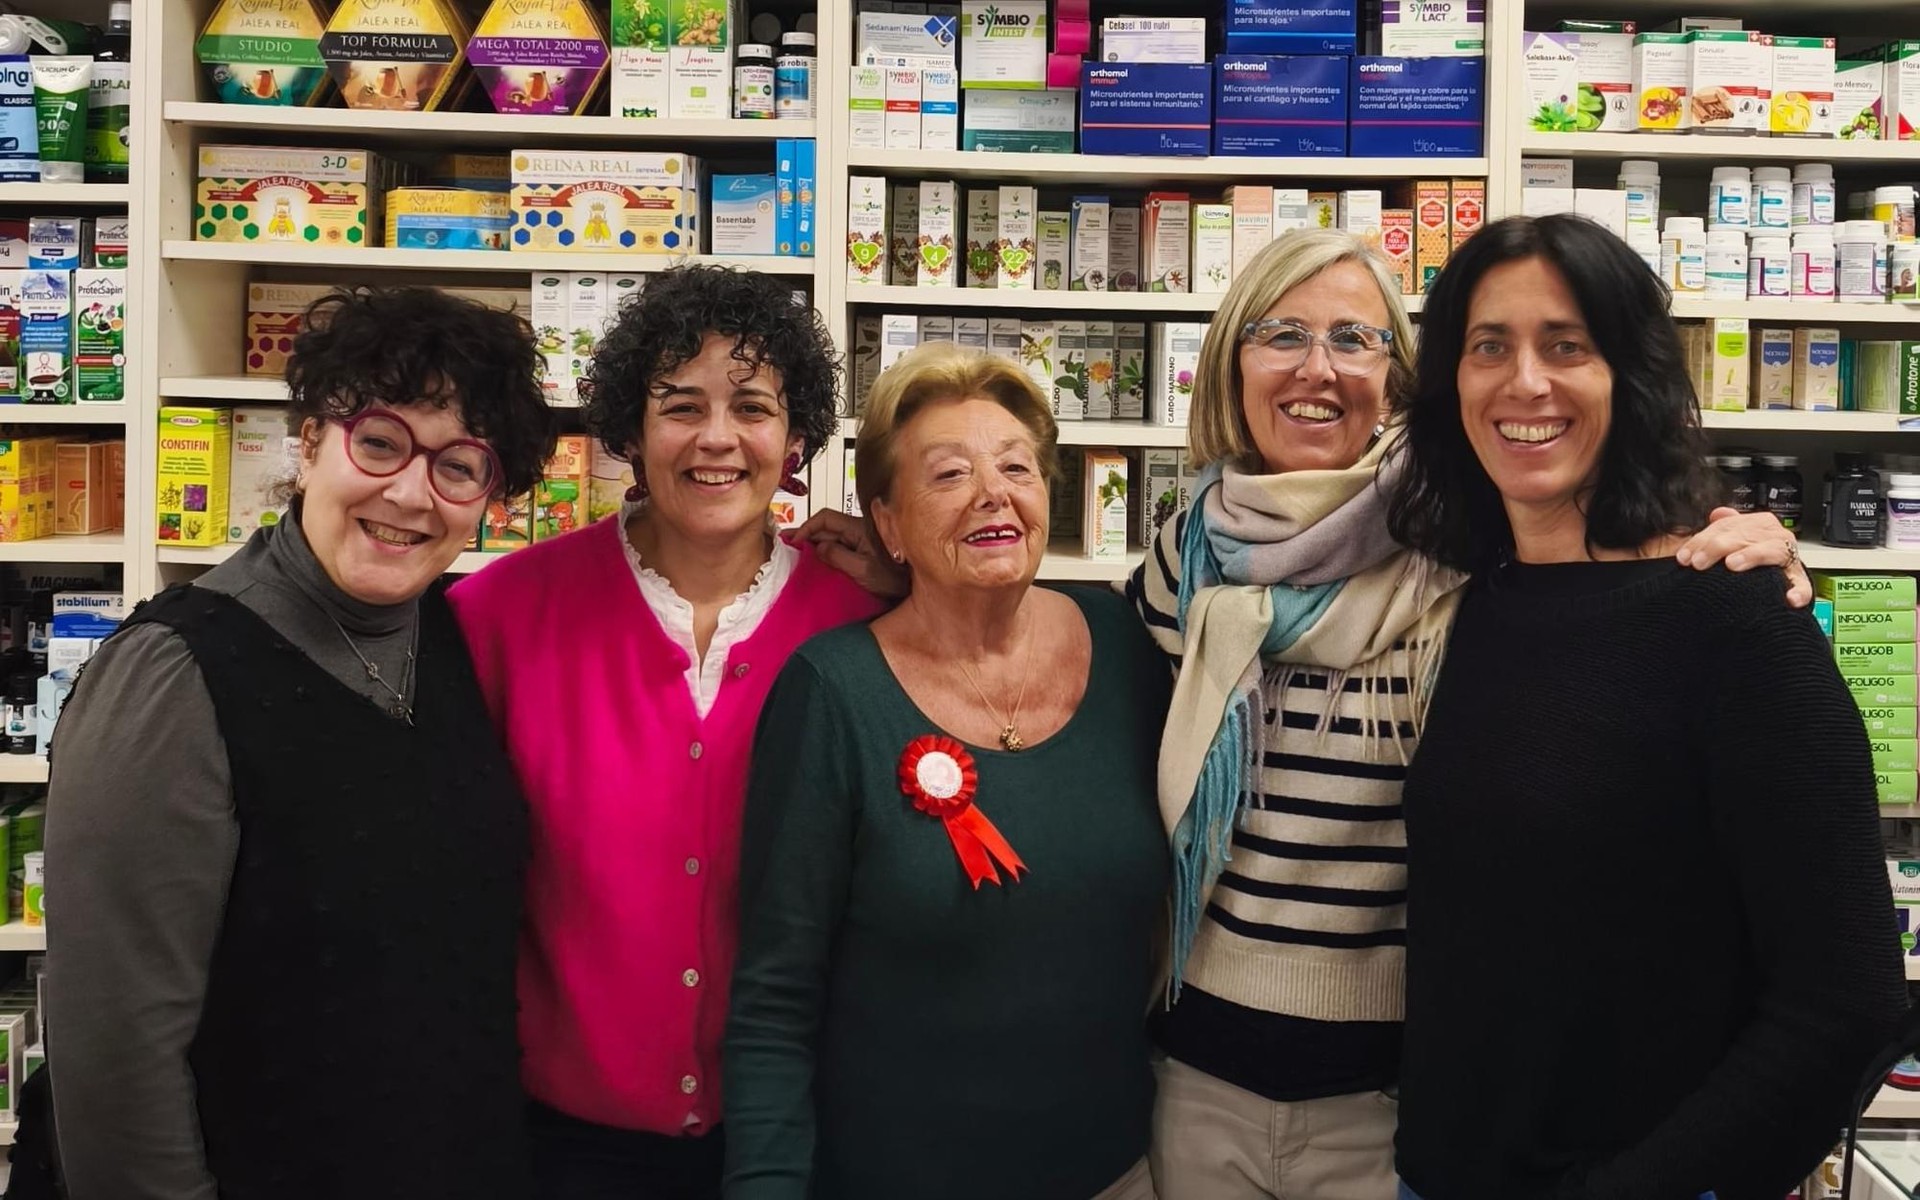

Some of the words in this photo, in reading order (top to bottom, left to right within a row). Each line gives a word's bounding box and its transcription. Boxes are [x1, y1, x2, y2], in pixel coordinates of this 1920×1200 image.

[1234, 7, 1299, 16] Micronutrientes
[1301, 8, 1351, 17] importantes
[1410, 3, 1451, 14] SYMBIO
[240, 17, 271, 27] JALEA
[276, 19, 300, 28] REAL
[357, 17, 388, 26] JALEA
[394, 17, 419, 27] REAL
[977, 12, 1030, 31] SYMBIO
[1234, 17, 1253, 25] para
[1422, 13, 1447, 22] LACT
[511, 20, 541, 30] JALEA
[547, 21, 573, 30] REAL
[1153, 20, 1170, 30] nutri
[993, 28, 1025, 36] INTEST
[239, 40, 293, 53] STUDIO
[341, 36, 369, 47] TOP
[373, 35, 438, 48] FÓRMULA
[476, 39, 510, 49] MEGA
[515, 40, 551, 50] TOTAL
[554, 41, 582, 51] 2000
[585, 45, 599, 53] mg
[787, 59, 808, 67] robis
[1223, 61, 1267, 71] orthomol
[1360, 63, 1403, 72] orthomol
[1090, 69, 1128, 78] orthomol
[1223, 85, 1289, 94] Micronutrientes
[1291, 86, 1341, 95] importantes
[1844, 81, 1873, 89] Memory
[1090, 90, 1153, 99] Micronutrientes
[1155, 92, 1204, 101] importantes
[1451, 88, 1468, 96] para
[3, 96, 33, 105] CLASSIC
[1223, 95, 1242, 103] para
[1253, 95, 1291, 104] cartílago
[1359, 94, 1398, 102] formación
[1401, 103, 1422, 111] tejido
[321, 155, 348, 169] 3-D
[532, 158, 584, 172] REINA
[590, 160, 634, 173] REAL
[256, 176, 286, 191] JALEA
[286, 176, 310, 191] REAL
[571, 181, 601, 196] JALEA
[602, 181, 626, 196] REAL
[716, 215, 756, 224] Basentabs
[860, 247, 870, 260] 9
[930, 250, 938, 262] 4
[1007, 252, 1024, 264] 22
[976, 256, 988, 267] 14
[78, 285, 123, 297] ProtecSapin
[237, 430, 269, 440] Junior
[160, 438, 210, 452] CONSTIFIN
[237, 442, 263, 452] Tussi
[1144, 476, 1152, 501] NEGRO
[1837, 582, 1883, 591] INFOLIGO
[1884, 582, 1893, 591] A
[56, 596, 111, 608] stabilium
[1838, 614, 1883, 623] INFOLIGO
[1884, 614, 1893, 623] A
[1840, 646, 1886, 655] INFOLIGO
[1886, 646, 1894, 655] B
